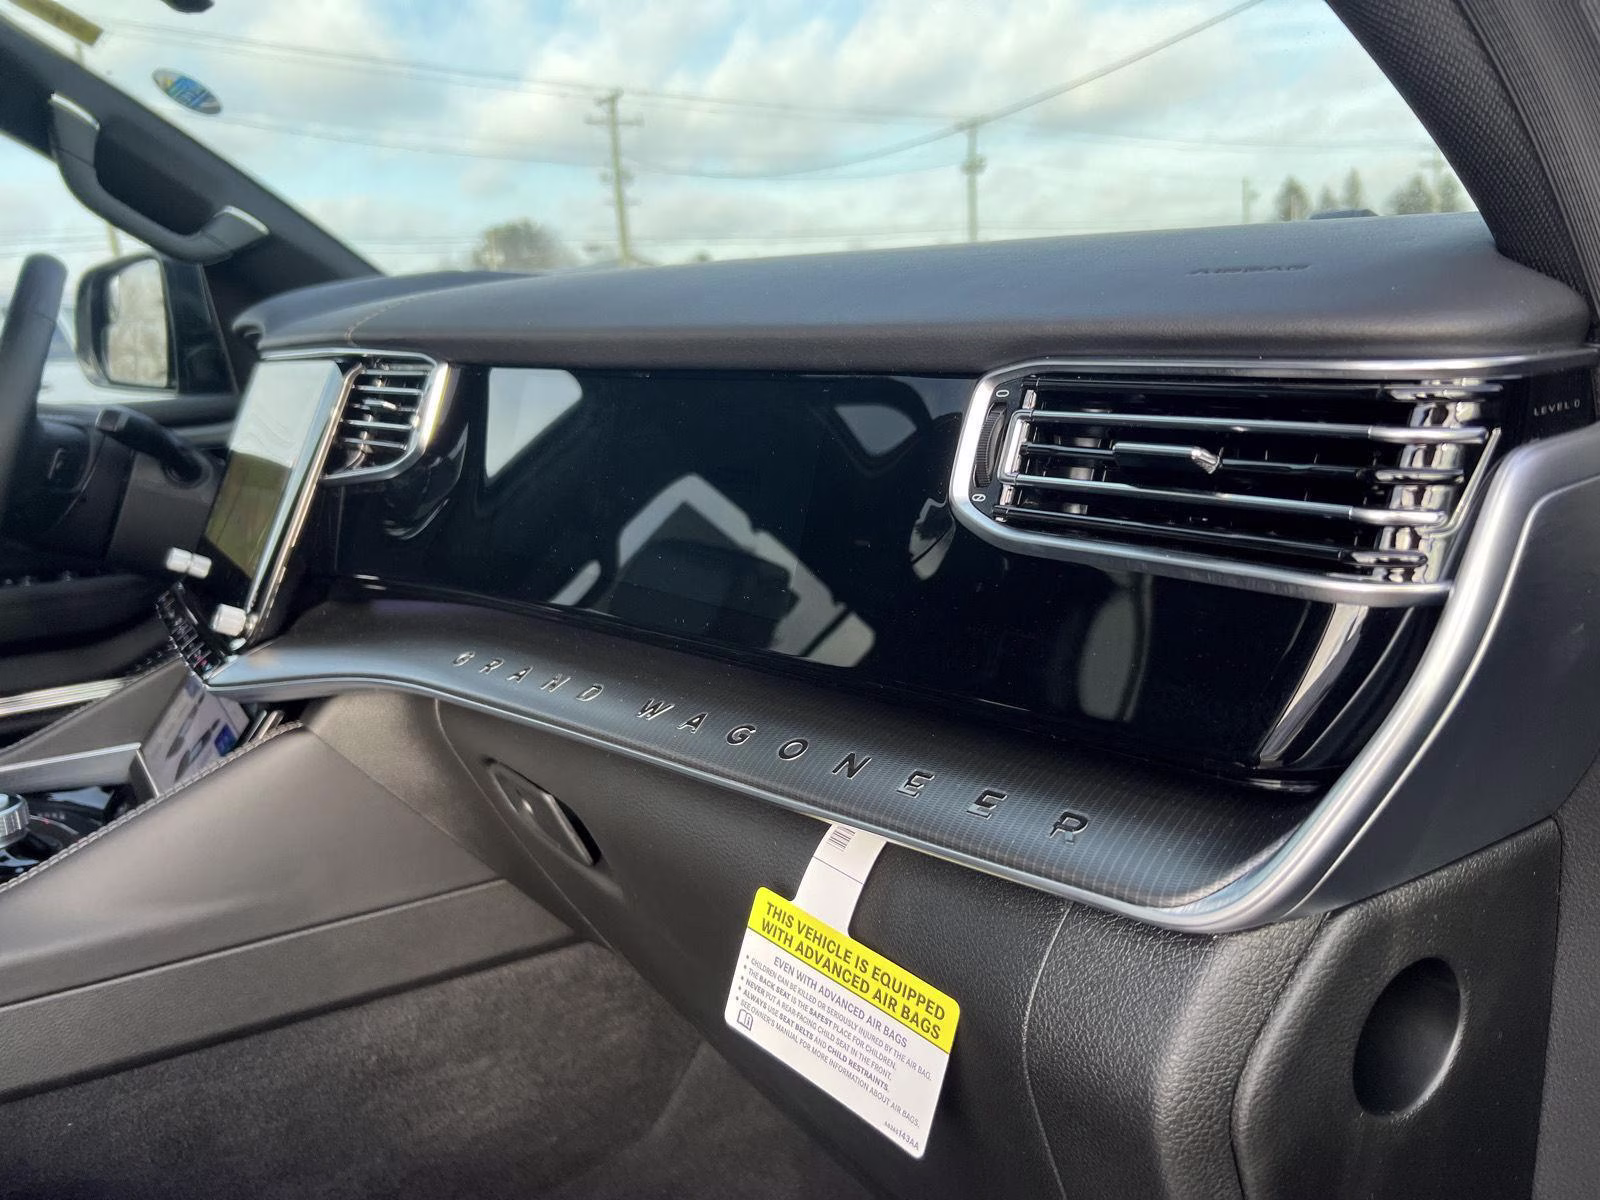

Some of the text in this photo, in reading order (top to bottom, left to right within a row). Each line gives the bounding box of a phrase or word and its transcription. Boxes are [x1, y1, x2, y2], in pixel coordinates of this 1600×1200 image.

[1533, 401, 1570, 417] LEVEL
[453, 651, 1090, 845] GRAND WAGONEER
[748, 968, 759, 980] THE
[759, 975, 776, 991] BACK
[775, 986, 791, 1001] SEAT
[791, 996, 797, 1005] IS
[797, 1000, 809, 1012] THE
[809, 1007, 833, 1028] SAFEST
[833, 1023, 852, 1040] PLACE
[852, 1035, 865, 1049] FOR
[760, 918, 942, 1041] WITH ADVANCED AIR BAGS
[765, 902, 947, 1022] THIS VEHICLE IS EQUIPPED
[773, 956, 908, 1049] EVEN WITH ADVANCED AIR BAGS
[741, 999, 751, 1011] SEE
[775, 1022, 799, 1043] MANUAL
[799, 1038, 811, 1051] FOR
[811, 1046, 829, 1064] MORE
[829, 1058, 869, 1092] INFORMATION
[869, 1086, 891, 1106] ABOUT
[890, 1101, 902, 1115] AIR
[743, 989, 768, 1010] ALWAYS
[767, 1005, 779, 1018] USE
[779, 1012, 795, 1028] SEAT
[795, 1023, 814, 1041] BELTS
[814, 1036, 827, 1049] AND
[827, 1045, 848, 1063] CHILD
[746, 978, 766, 996] NEVER
[765, 991, 777, 1003] PUT
[776, 998, 782, 1007] A
[817, 1025, 836, 1042] CHILD
[835, 1037, 850, 1052] SEAT
[850, 1047, 858, 1057] IN
[858, 1052, 871, 1066] THE
[751, 958, 777, 979] CHILDREN
[777, 974, 790, 987] CAN
[789, 982, 798, 992] BE
[797, 987, 817, 1005] KILLED
[817, 1000, 826, 1011] OR
[826, 1006, 858, 1031] SERIOUSLY
[858, 1027, 884, 1049] INJURED
[884, 1043, 892, 1054] BY
[892, 1049, 906, 1063] THE
[906, 1058, 917, 1071] AIR
